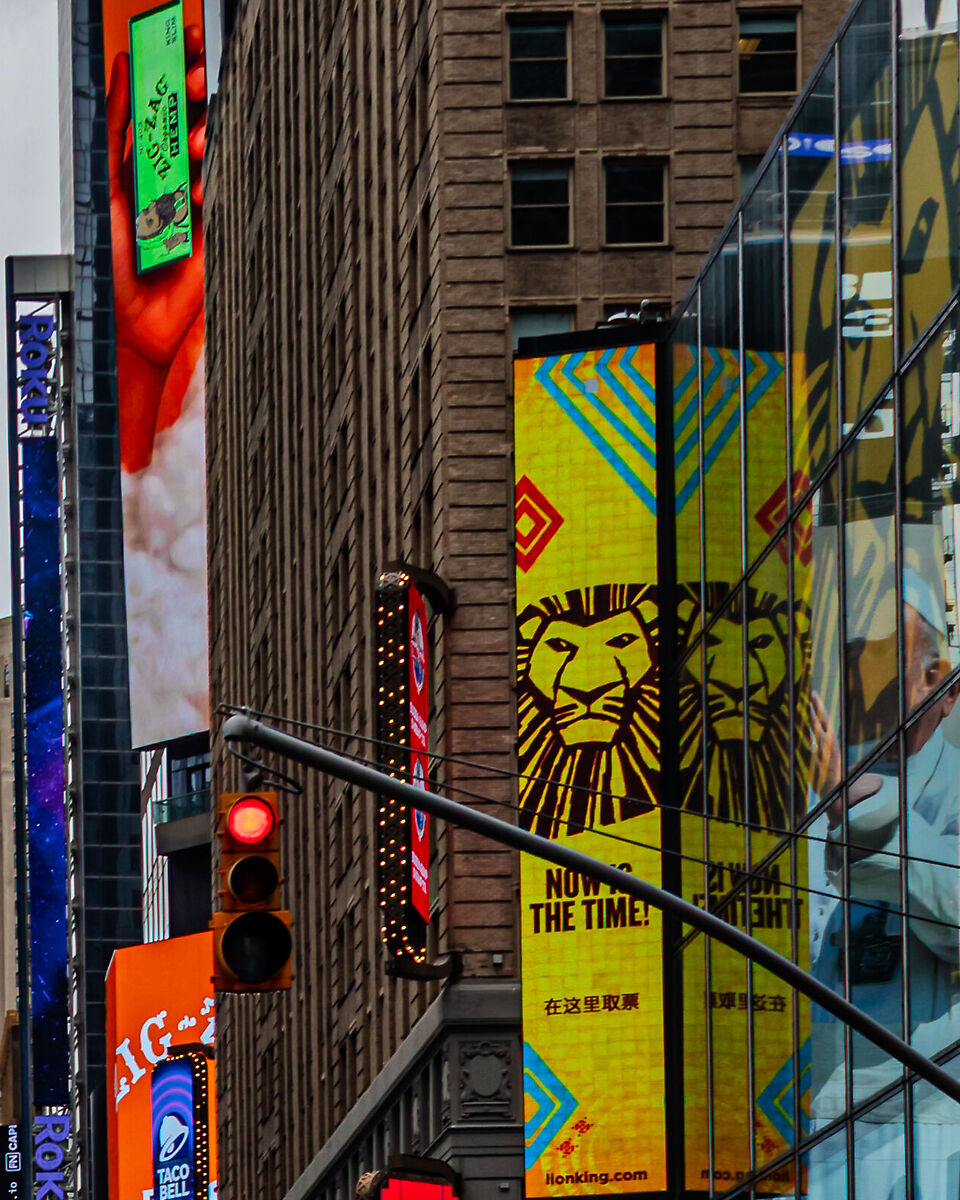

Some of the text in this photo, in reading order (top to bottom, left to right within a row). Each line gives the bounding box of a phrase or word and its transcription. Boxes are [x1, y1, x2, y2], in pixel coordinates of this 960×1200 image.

[144, 73, 173, 180] ZIG-ZAG
[167, 91, 180, 158] HEMP
[529, 896, 650, 934] THE TIME!
[544, 992, 640, 1017] 在这里取票
[157, 1163, 190, 1184] TACO
[545, 1168, 648, 1186] lionking.com
[159, 1180, 191, 1200] BELL
